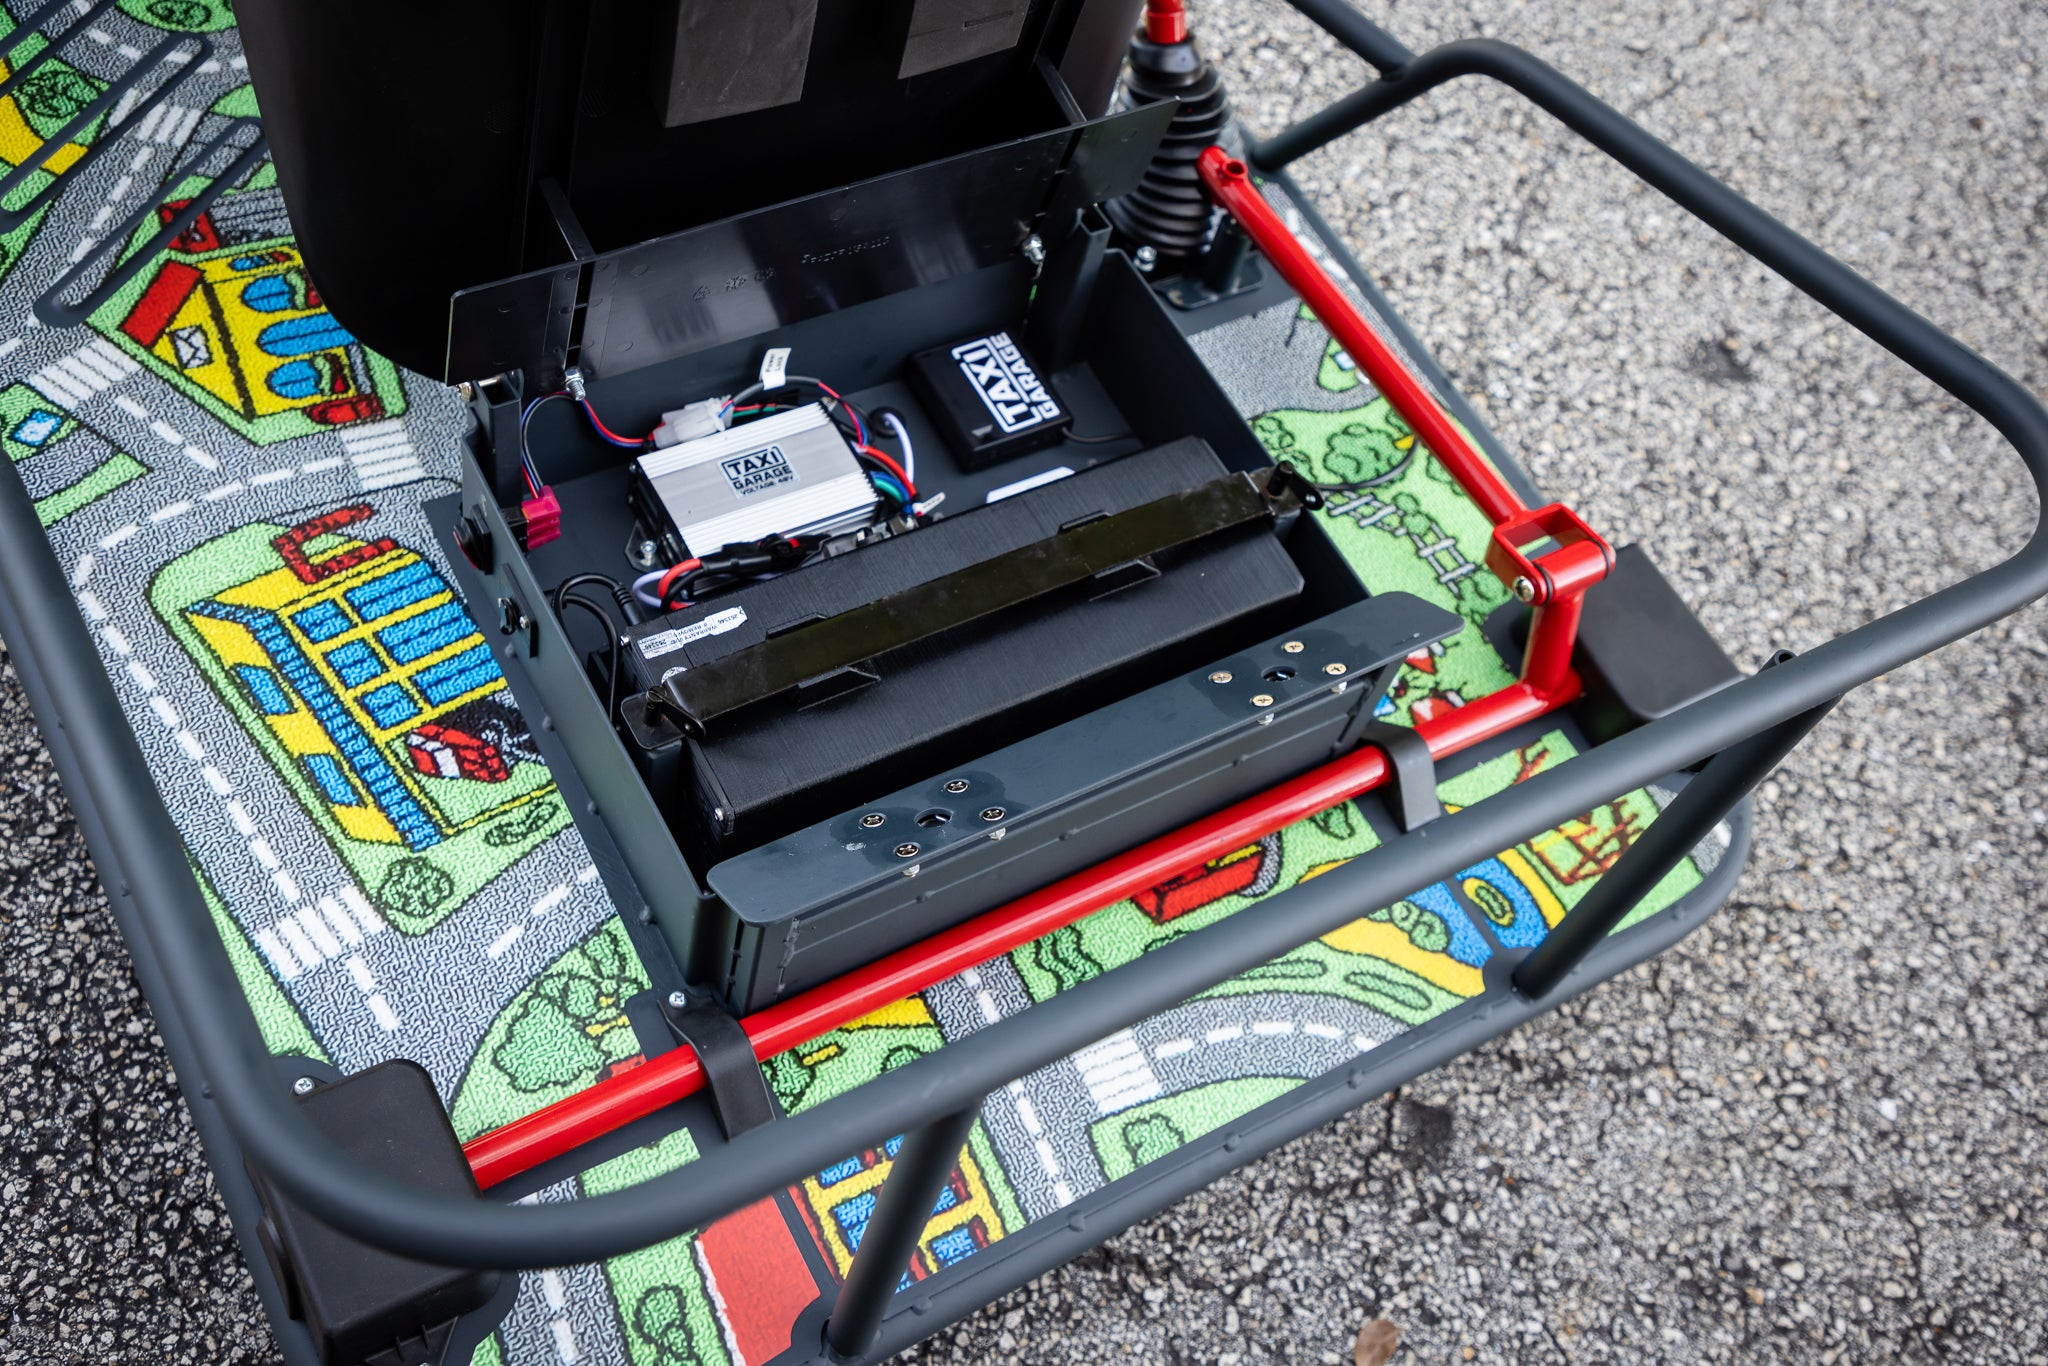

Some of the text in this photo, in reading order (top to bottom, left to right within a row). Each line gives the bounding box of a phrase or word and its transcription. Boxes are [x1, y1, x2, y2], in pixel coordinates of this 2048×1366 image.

[962, 348, 1029, 425] TAXI
[989, 332, 1060, 418] GARAGE
[726, 450, 779, 475] TAXI
[732, 464, 792, 490] GARAGE
[683, 624, 718, 640] WARRANTY
